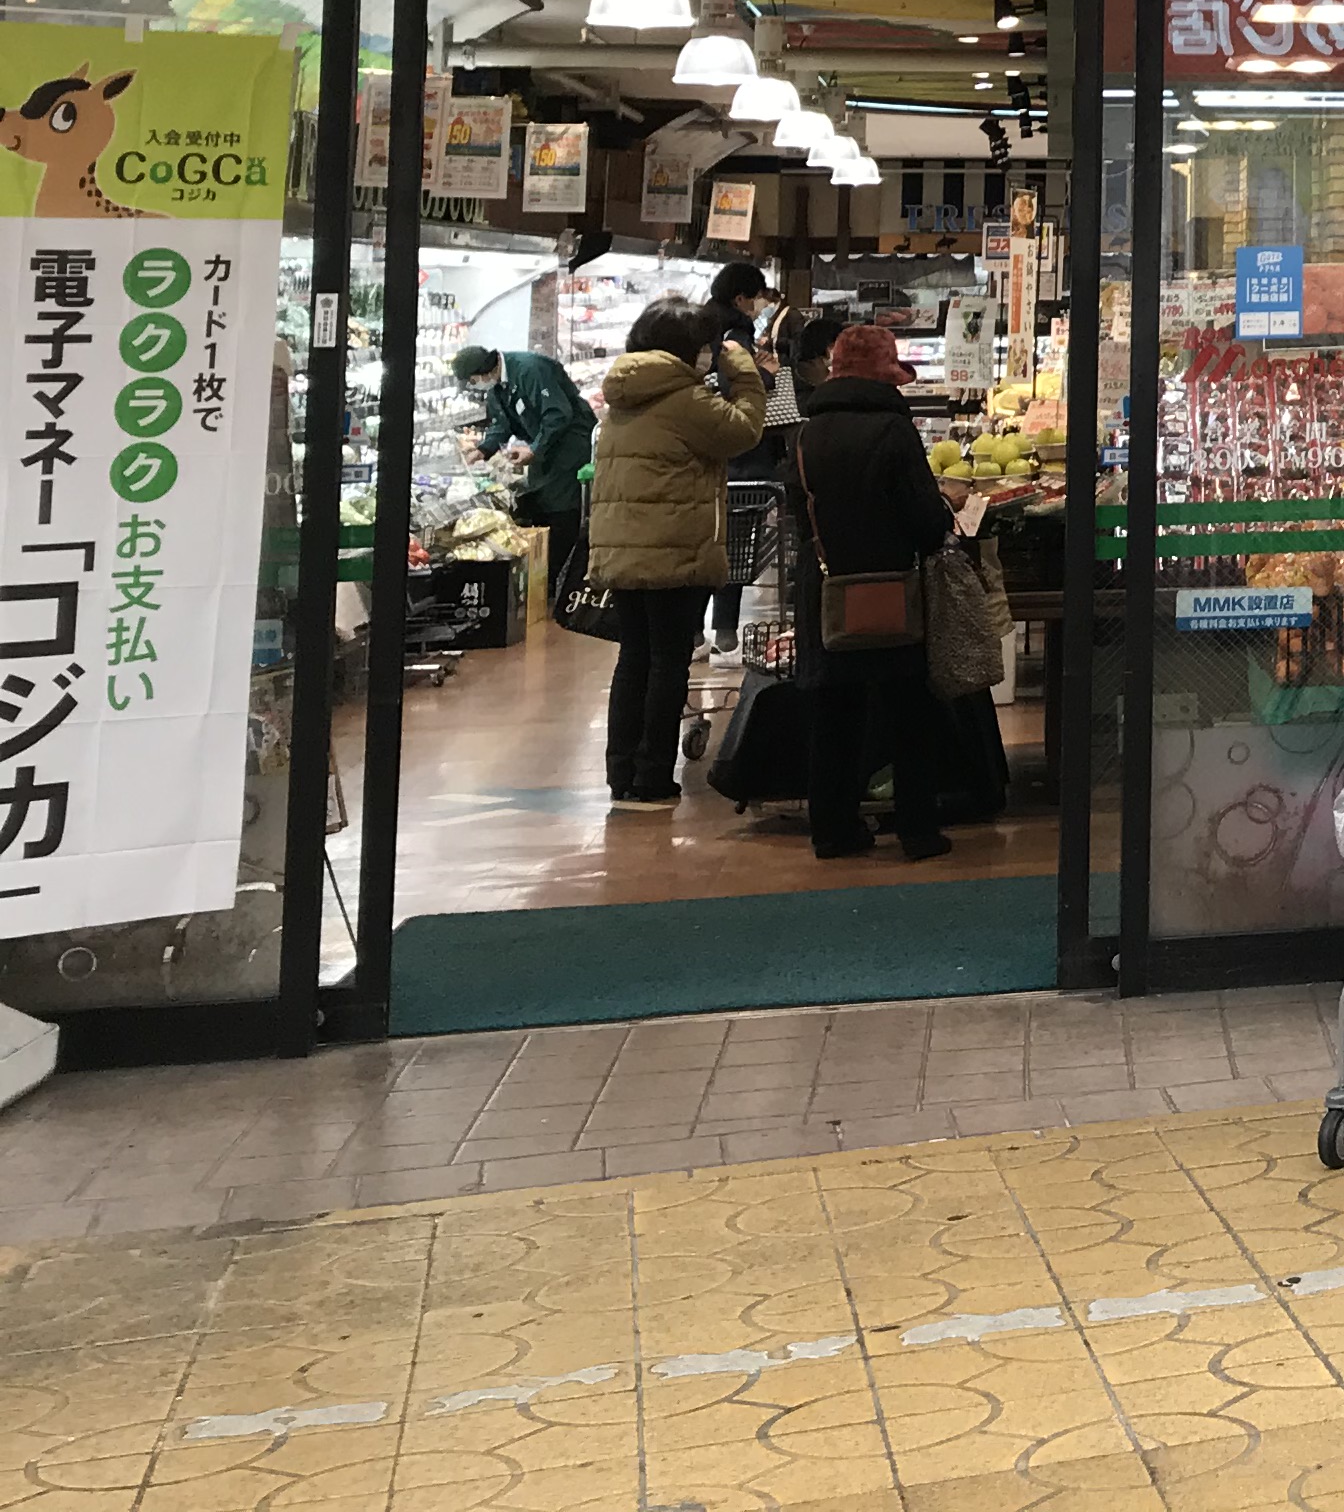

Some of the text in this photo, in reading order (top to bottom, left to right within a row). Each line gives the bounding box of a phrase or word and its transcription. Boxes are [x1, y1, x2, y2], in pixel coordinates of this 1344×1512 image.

[145, 129, 241, 147] 入会受付中
[171, 188, 217, 202] コジカ
[193, 253, 232, 433] カード1枚で
[1193, 594, 1295, 613] MMK設置店
